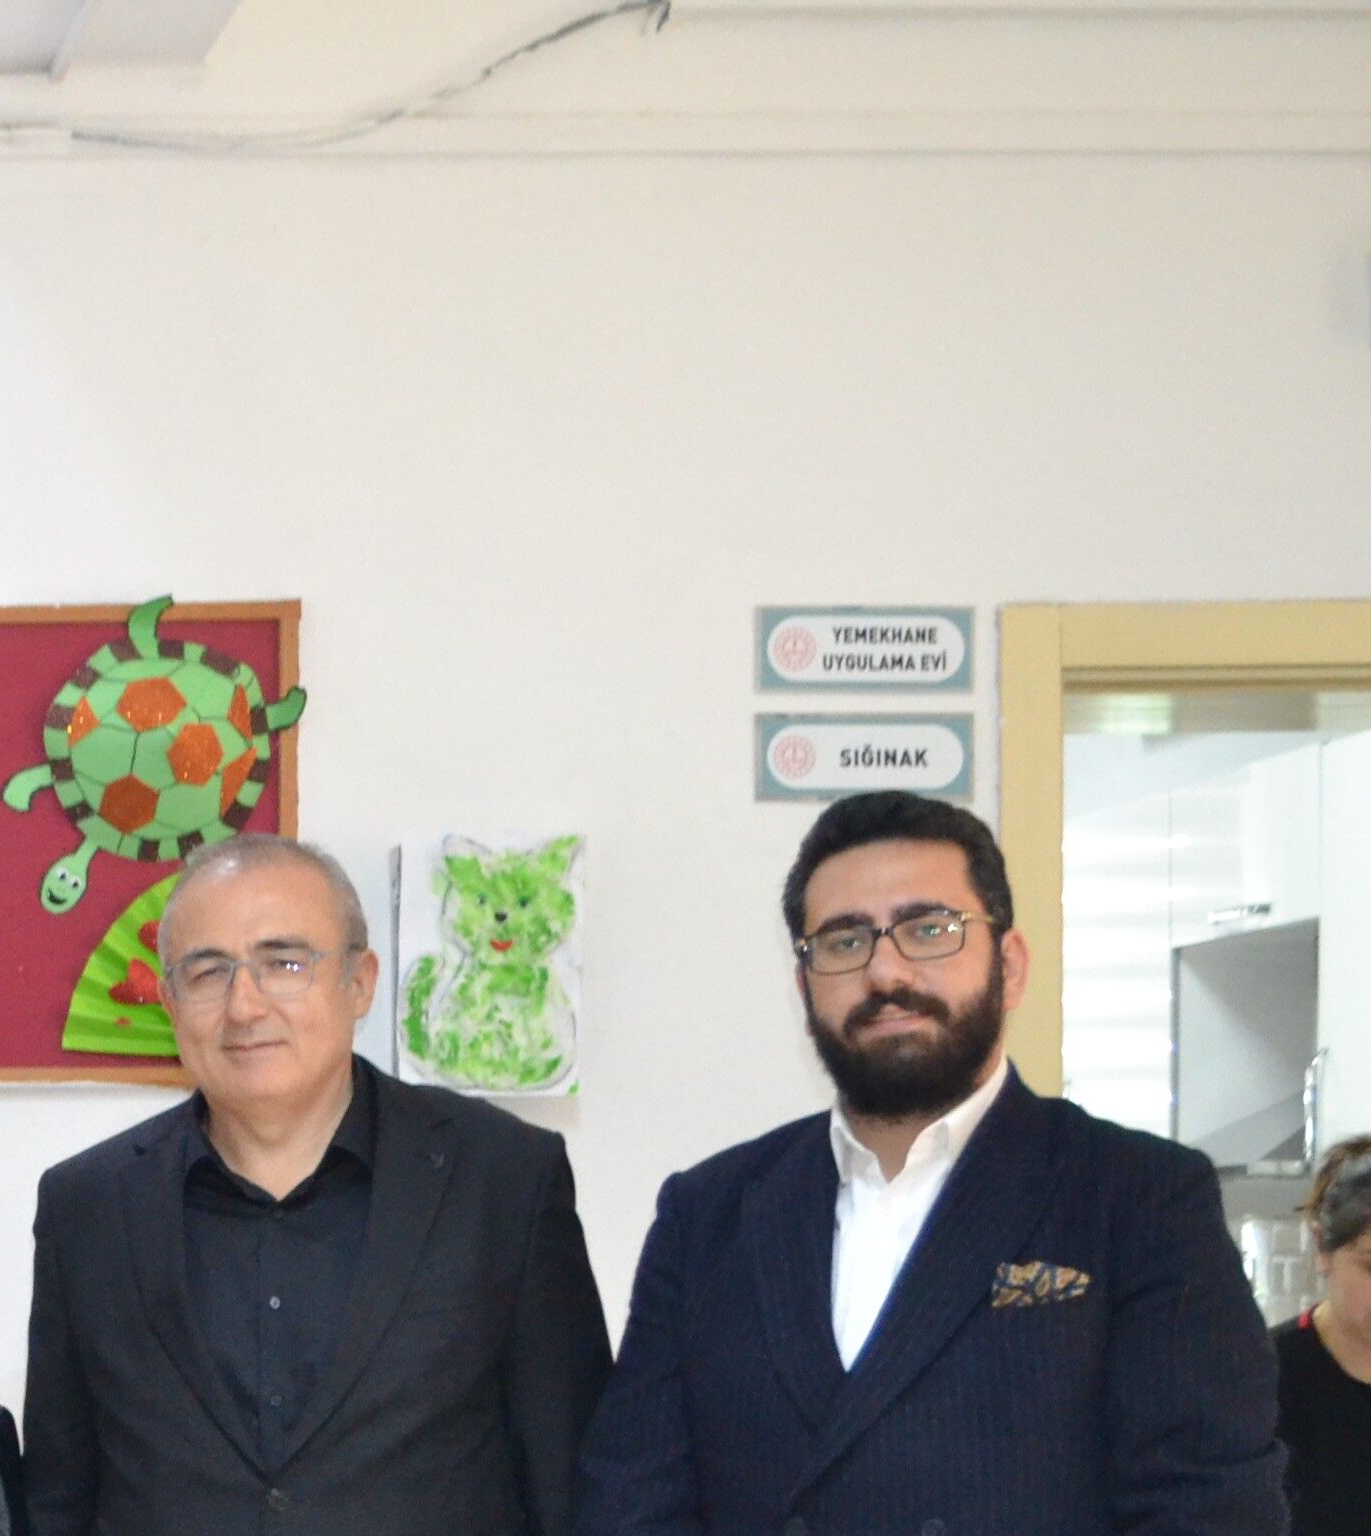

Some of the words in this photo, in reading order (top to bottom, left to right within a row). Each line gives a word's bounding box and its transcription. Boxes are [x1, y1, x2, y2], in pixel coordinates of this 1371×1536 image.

[832, 626, 938, 645] YEMEKHANE
[822, 653, 916, 672] UYGULAMA
[920, 649, 948, 672] EVİ
[839, 744, 929, 768] SIĞINAK
